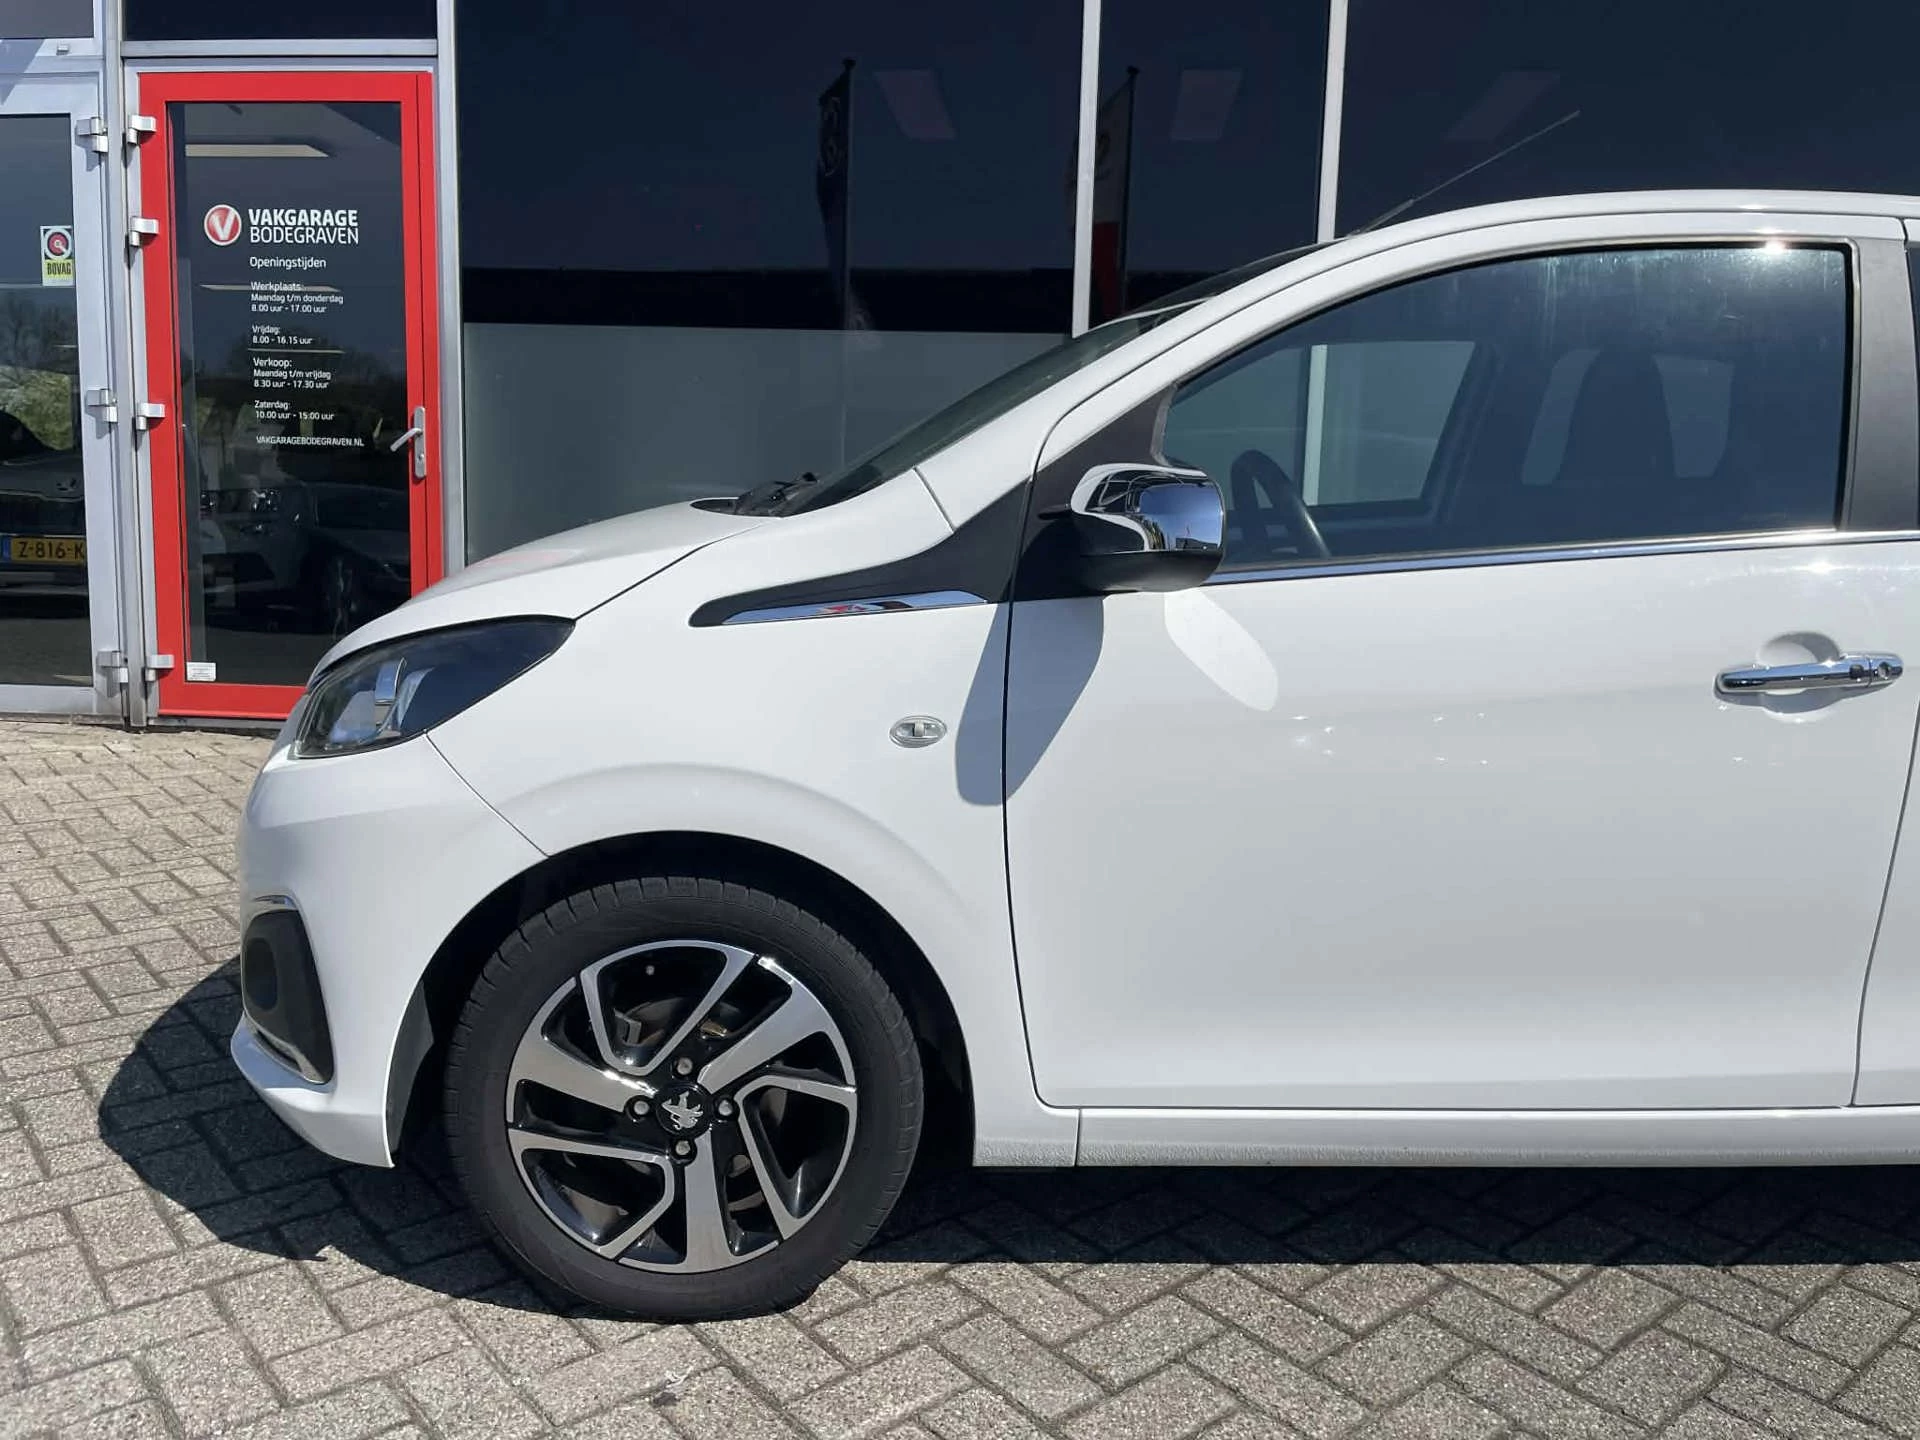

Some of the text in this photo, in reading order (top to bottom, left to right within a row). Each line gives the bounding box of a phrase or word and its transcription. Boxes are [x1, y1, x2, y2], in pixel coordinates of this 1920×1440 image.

[249, 208, 358, 227] VAKGARAGE
[250, 226, 359, 245] BODEGRAVEN
[250, 256, 326, 270] Openingstijden
[47, 262, 72, 276] BOVAG
[251, 293, 285, 304] Maandag
[303, 295, 343, 305] donderdag
[291, 304, 312, 313] 17.00
[277, 336, 298, 344] 16.15
[253, 357, 292, 369] Verkoop:
[254, 369, 332, 380] Maandag t/m vrijdag
[254, 380, 271, 388] 8.30
[293, 380, 315, 388] 17.30
[255, 411, 277, 419] 10.00
[256, 436, 365, 447] VAKGARAGEBODEGRAVEN.NL
